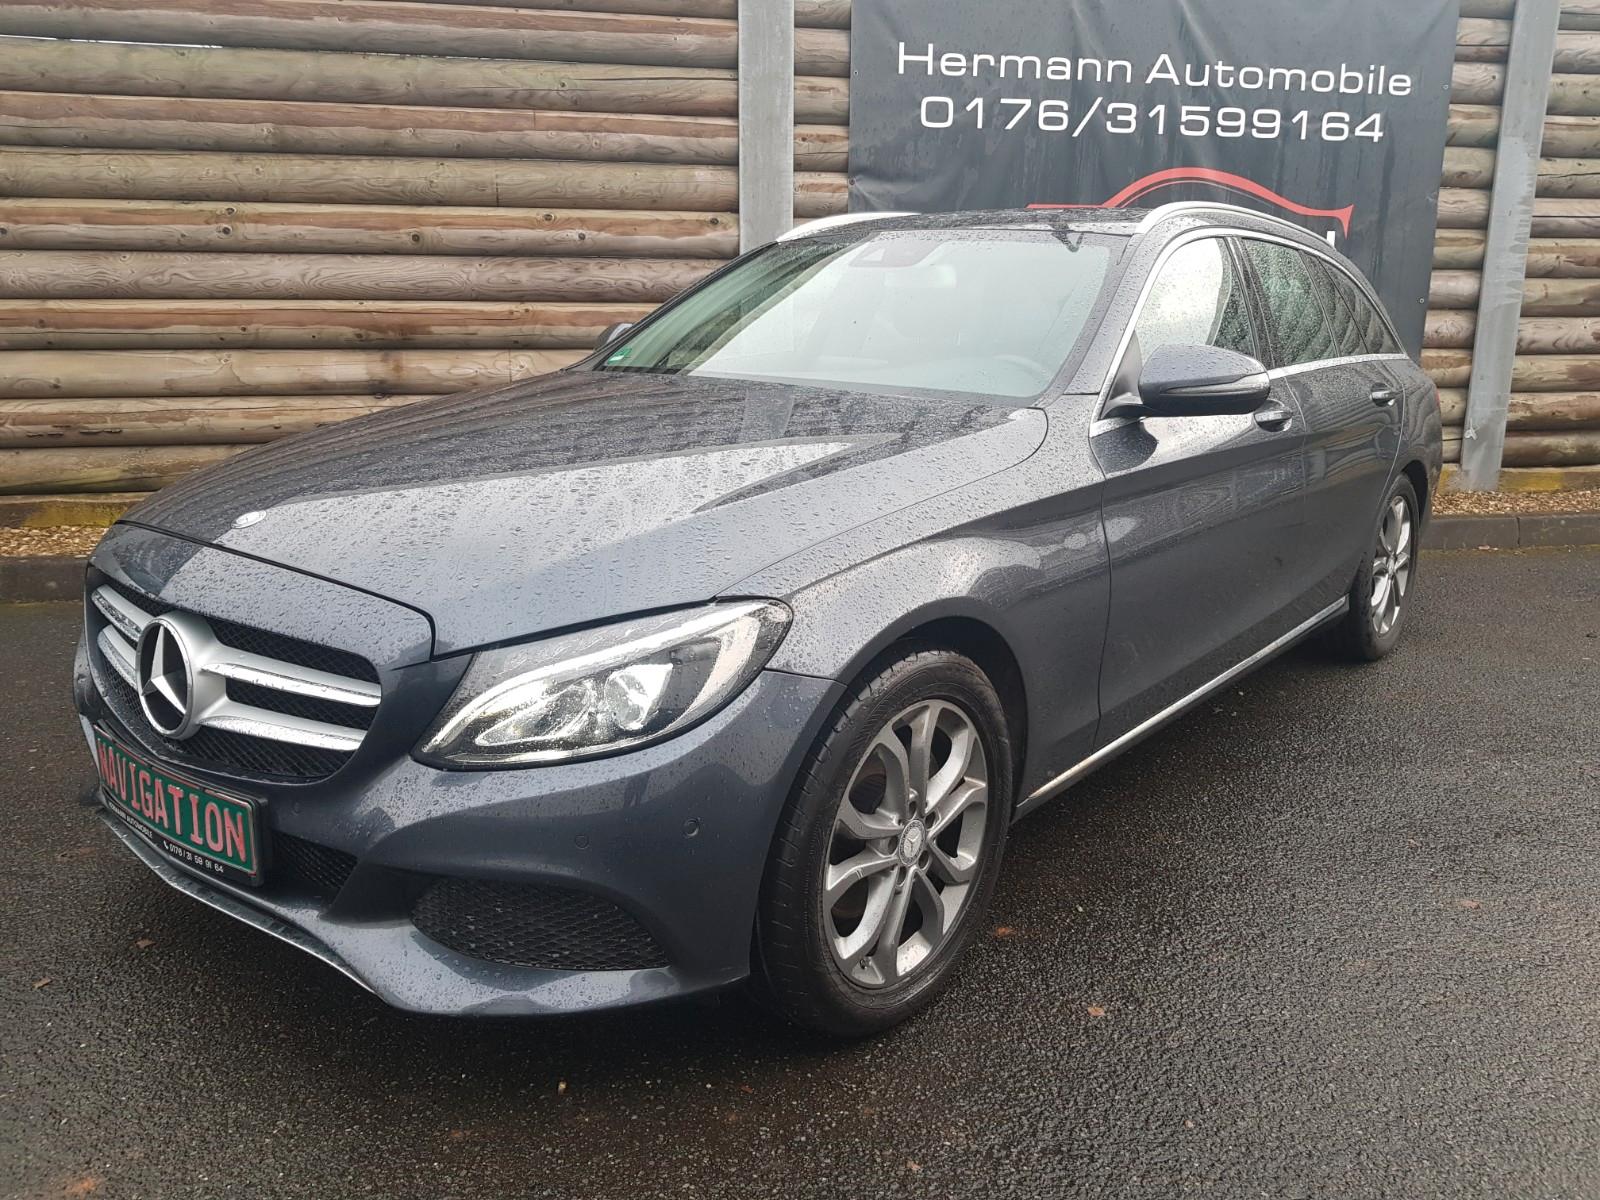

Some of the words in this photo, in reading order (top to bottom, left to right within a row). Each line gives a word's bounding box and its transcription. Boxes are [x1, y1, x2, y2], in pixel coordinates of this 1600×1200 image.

[897, 42, 1133, 83] Hermann
[1145, 52, 1413, 97] Automobile
[919, 96, 1385, 143] 0176/31599164
[96, 736, 248, 864] NAVIGATION
